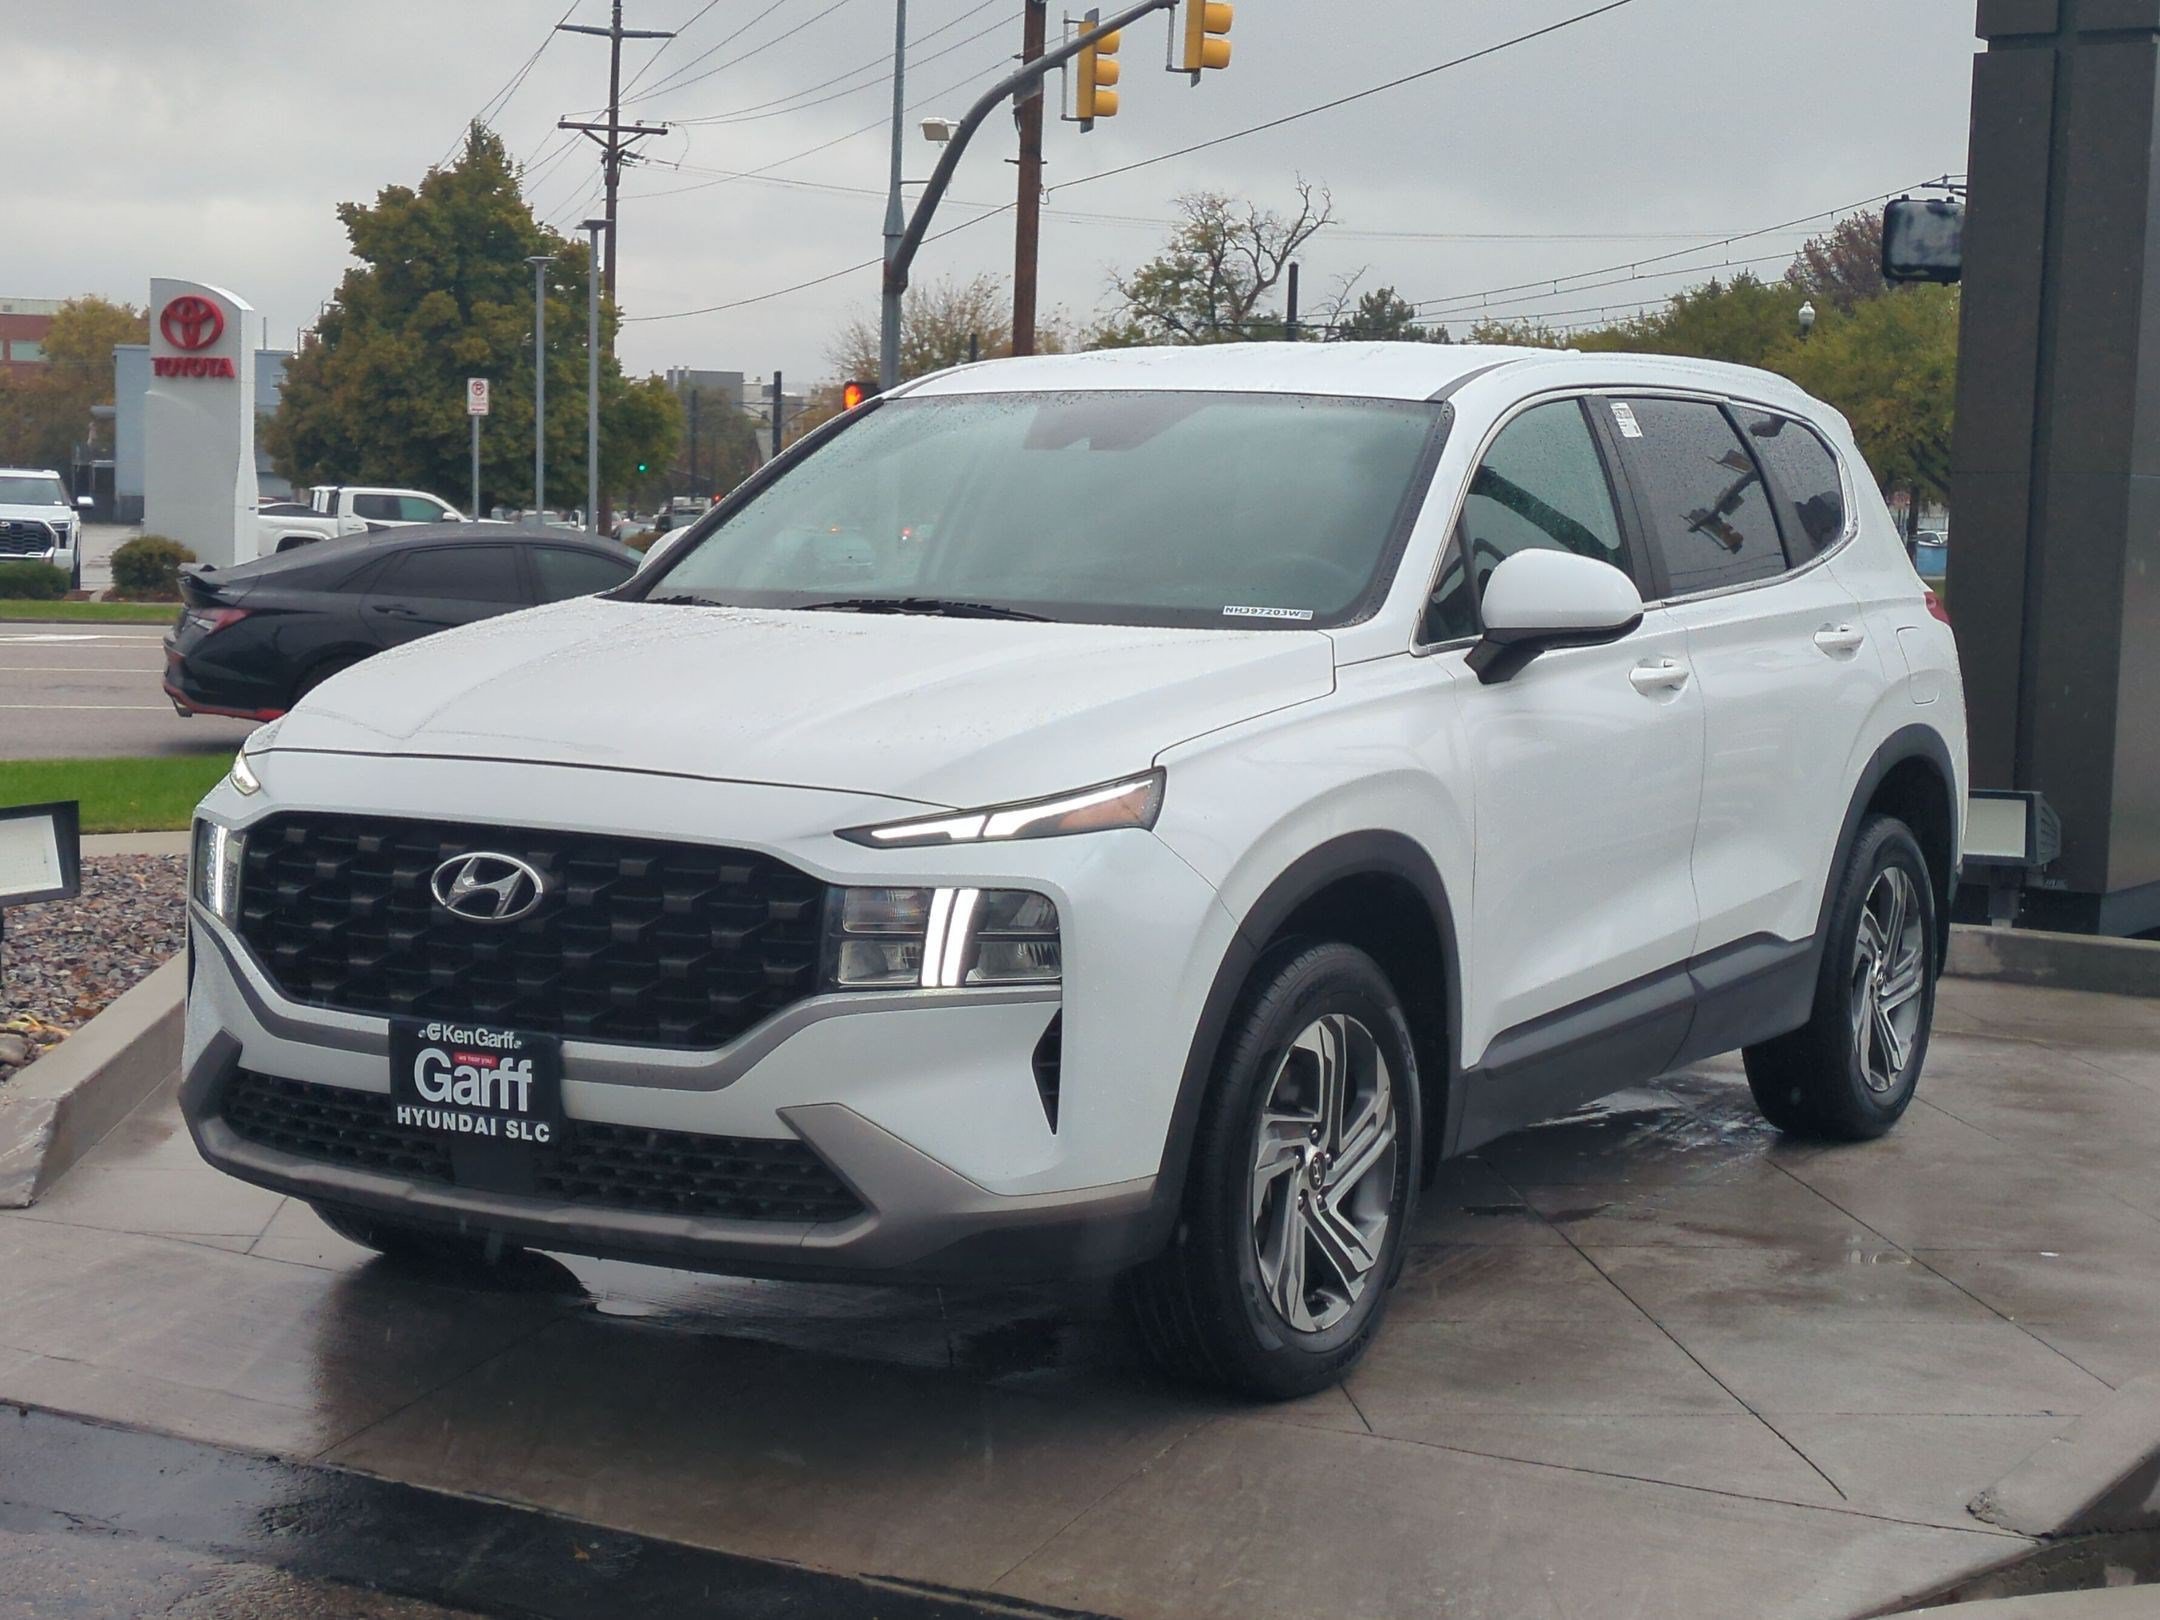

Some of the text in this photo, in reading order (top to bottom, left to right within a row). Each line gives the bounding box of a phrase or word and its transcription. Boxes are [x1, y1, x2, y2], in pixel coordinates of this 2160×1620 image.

[151, 356, 235, 378] TOYOTA
[442, 1024, 514, 1049] Ken Garff
[414, 1047, 532, 1112] Garff
[397, 1106, 550, 1142] HYUNDAI SLC
